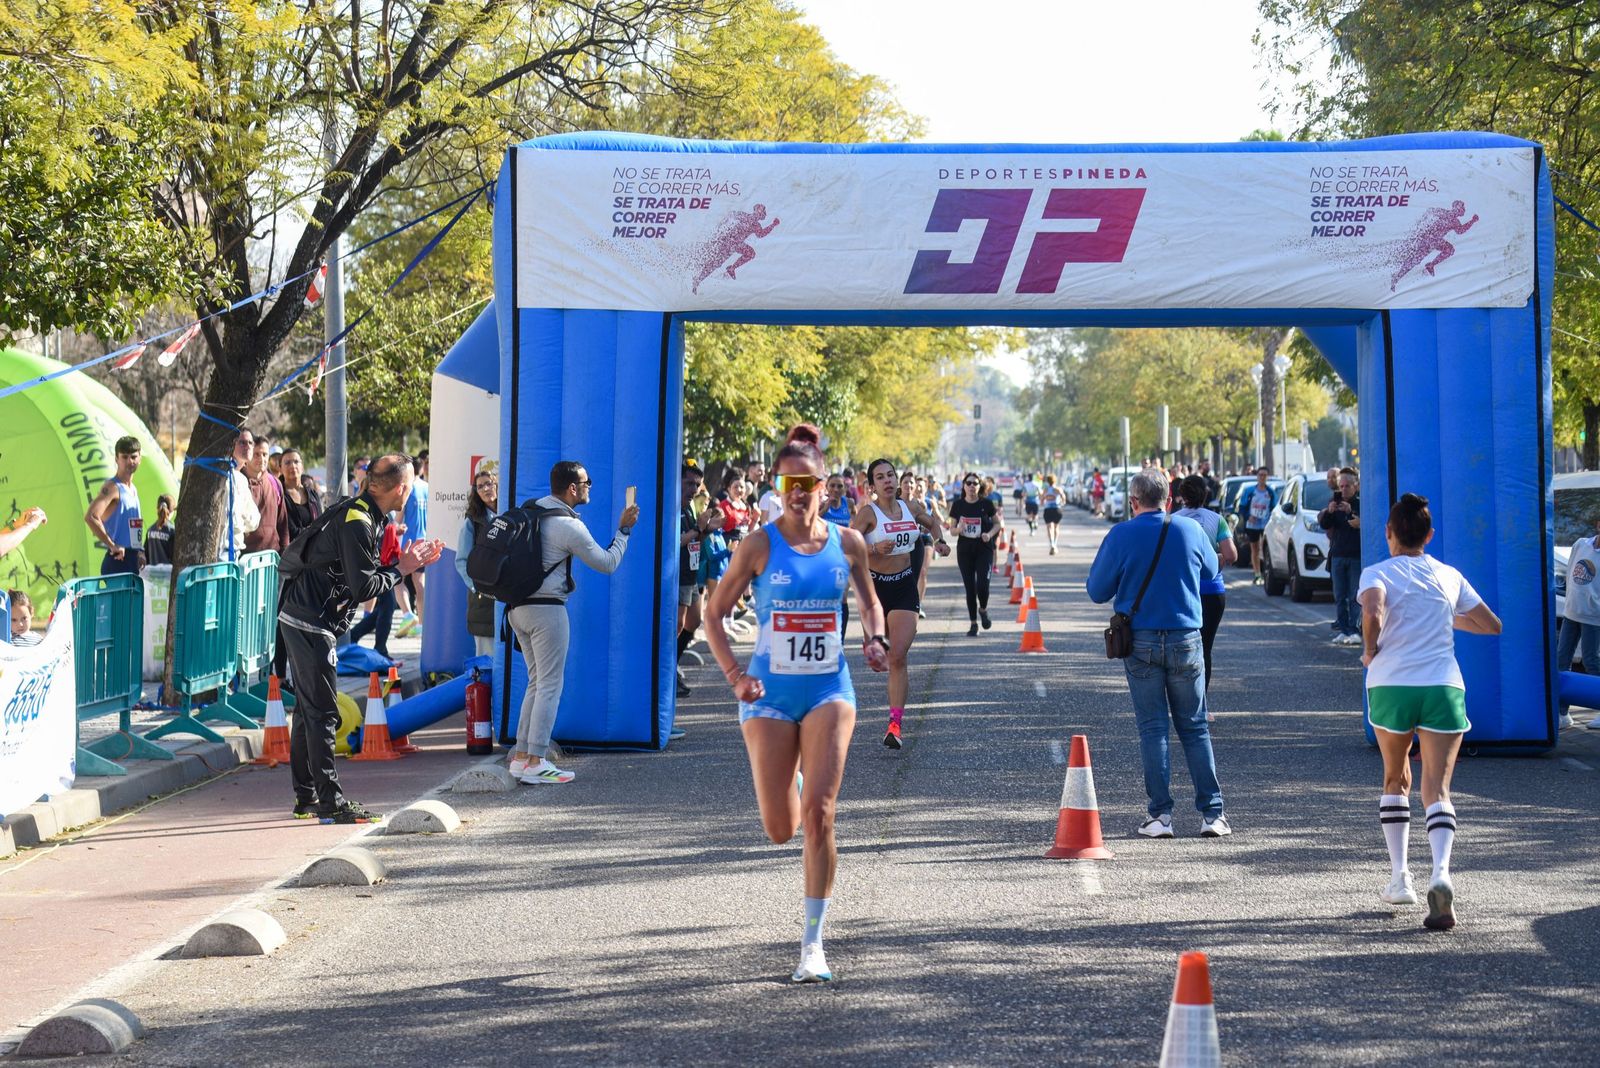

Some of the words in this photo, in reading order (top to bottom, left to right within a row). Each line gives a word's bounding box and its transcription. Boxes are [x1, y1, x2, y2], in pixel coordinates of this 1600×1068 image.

[612, 167, 638, 180] NO
[641, 167, 661, 180] SE
[665, 167, 712, 180] TRATA
[1310, 166, 1334, 179] NO
[1337, 166, 1358, 179] SE
[1362, 165, 1409, 178] TRATA
[612, 181, 635, 194] DE
[638, 182, 701, 195] CORRER
[1310, 181, 1332, 193] DE
[1335, 180, 1400, 193] CORRER
[613, 196, 633, 209] SE
[637, 197, 685, 209] TRATA
[689, 197, 711, 209] DE
[1310, 196, 1331, 208] SE
[1335, 195, 1384, 208] TRATA
[1387, 195, 1410, 207] DE
[612, 211, 677, 224] CORRER
[1310, 210, 1375, 223] CORRER
[612, 226, 667, 239] MEJOR
[1310, 225, 1366, 238] MEJOR
[878, 573, 901, 582] NIKE
[787, 635, 826, 662] 145
